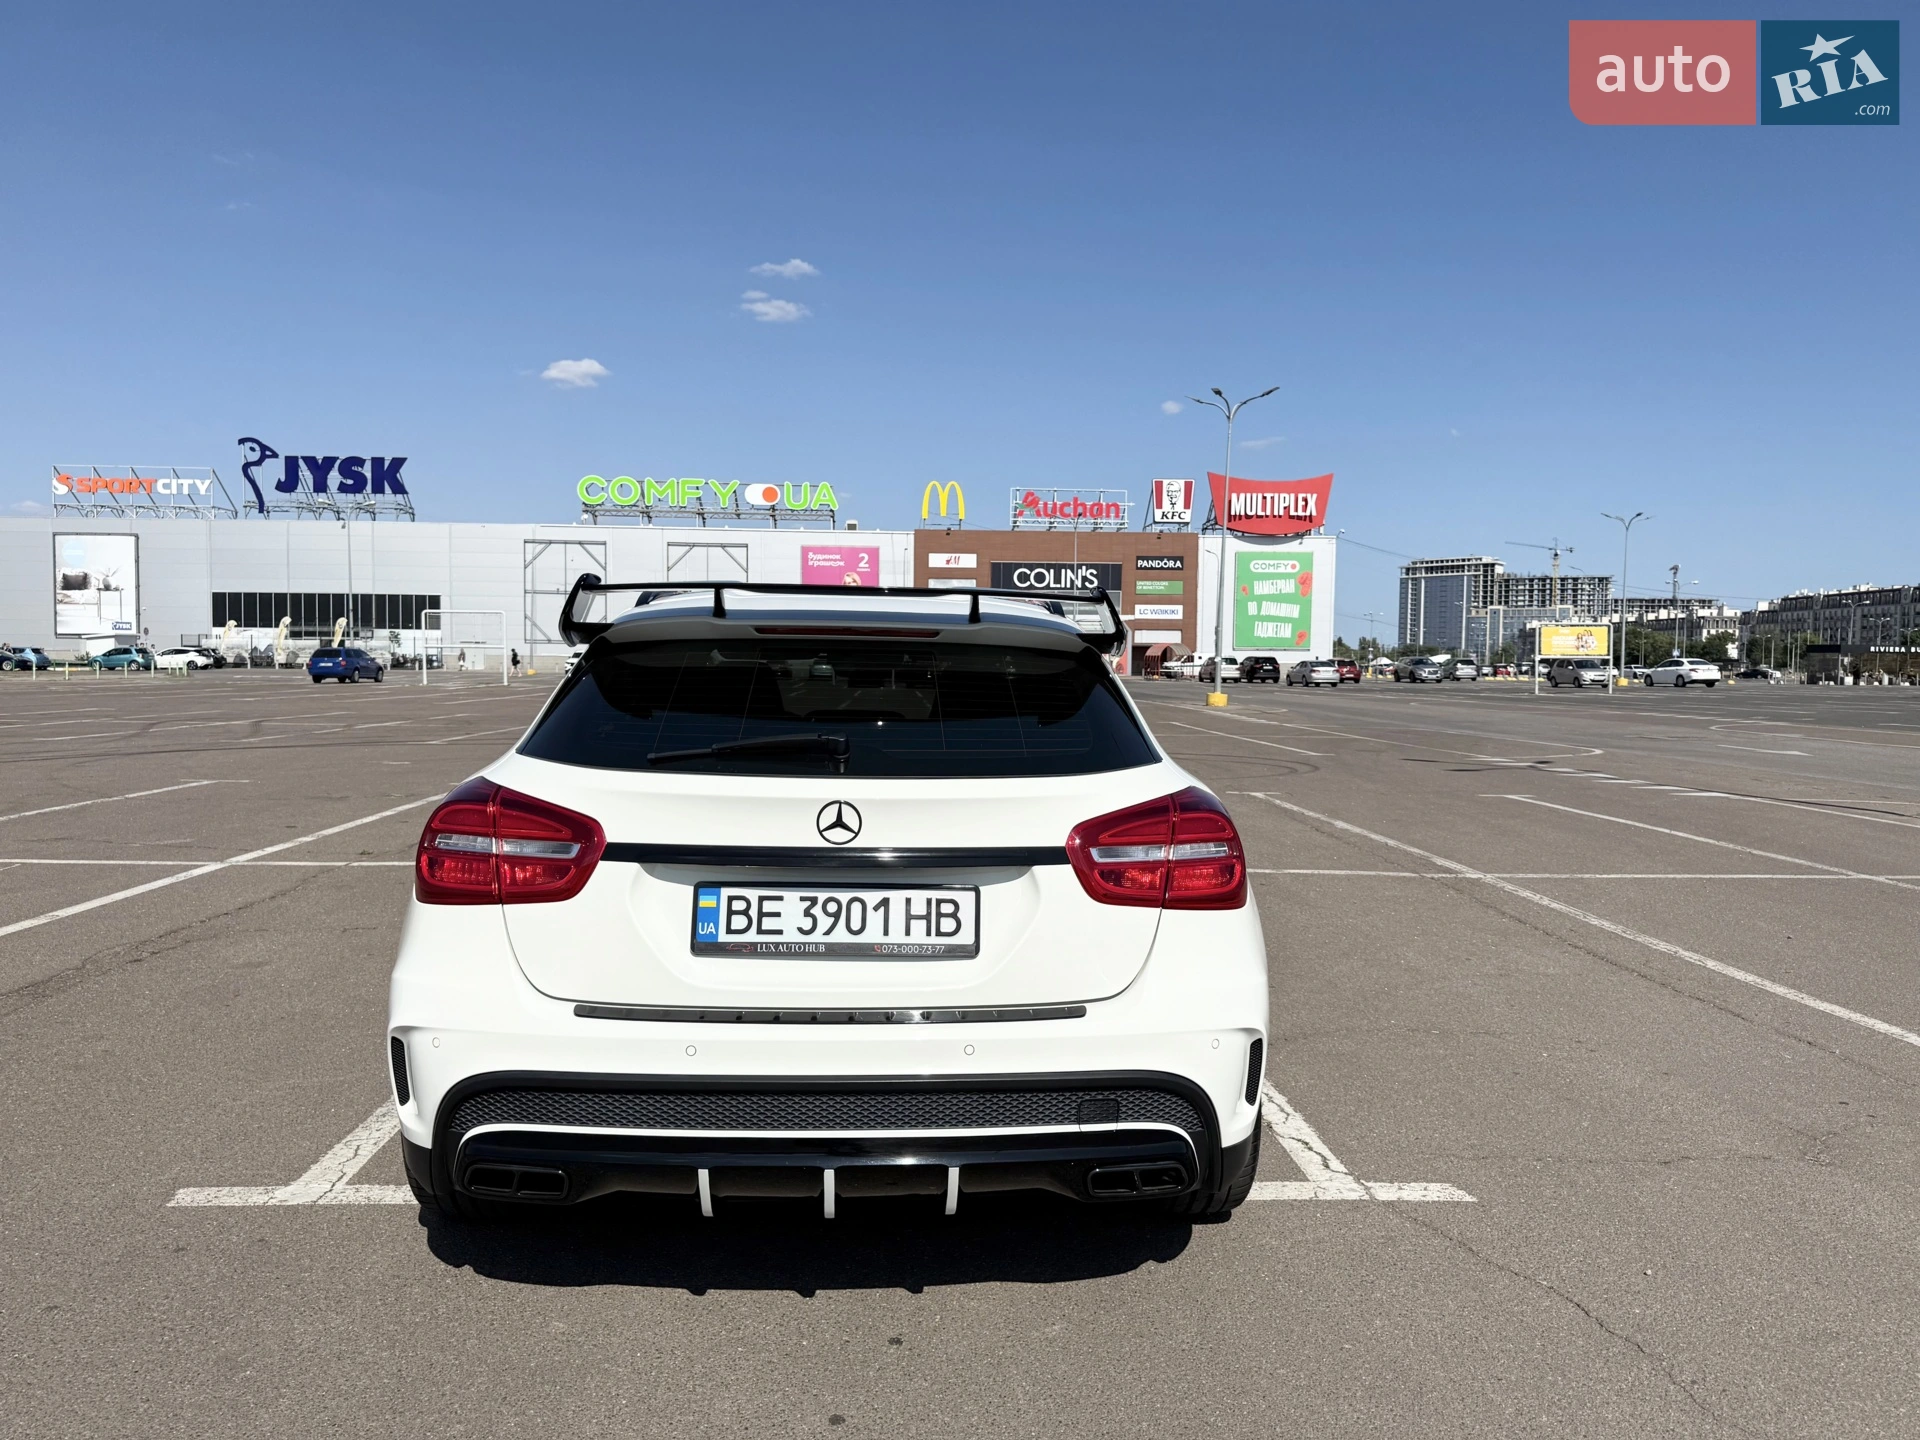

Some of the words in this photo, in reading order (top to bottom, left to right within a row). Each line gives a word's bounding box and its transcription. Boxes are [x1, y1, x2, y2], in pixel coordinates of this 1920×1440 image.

[274, 455, 409, 495] JYSK
[577, 474, 741, 509] COMFY
[783, 481, 839, 511] UA
[1017, 490, 1121, 519] Auchan
[1230, 492, 1318, 517] MULTIPLEX
[1160, 511, 1187, 520] KFC
[858, 552, 869, 568] 2
[1137, 559, 1182, 568] PANDORA
[1252, 562, 1290, 570] COMFY
[1013, 565, 1099, 589] COLIN'S
[726, 895, 784, 935] BE
[796, 896, 890, 936] 3901
[905, 897, 962, 937] HB
[699, 922, 716, 934] UA
[757, 944, 776, 952] LUX
[777, 944, 803, 952] AUTO
[805, 944, 825, 952] HUB
[881, 945, 945, 953] 073-000-73-77
